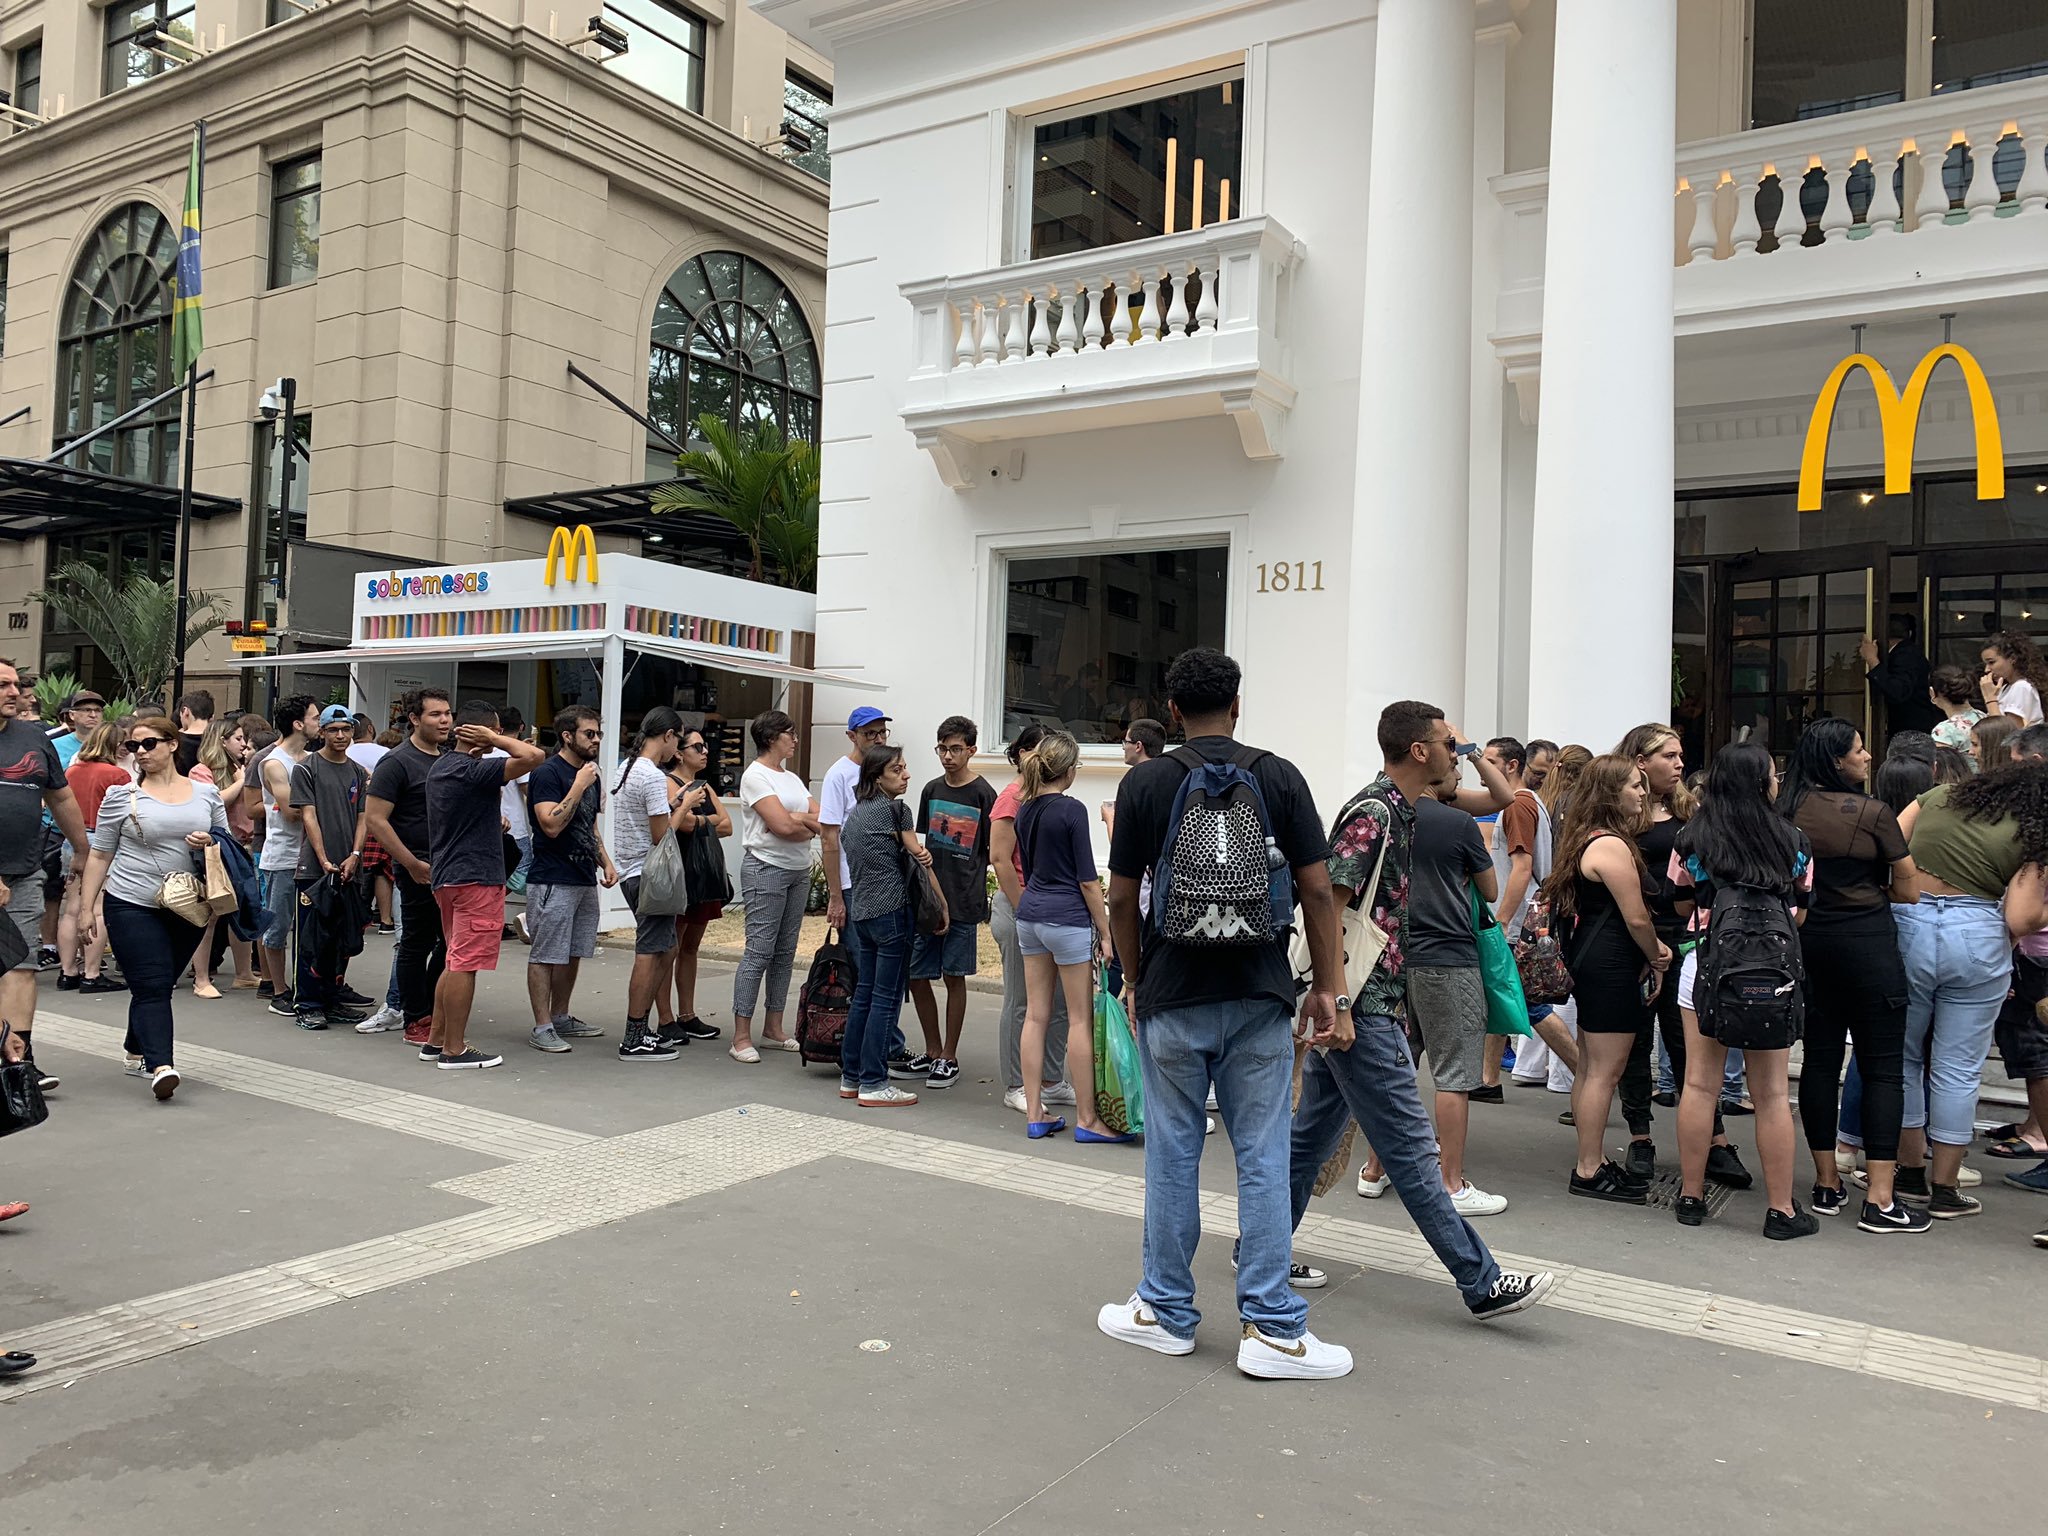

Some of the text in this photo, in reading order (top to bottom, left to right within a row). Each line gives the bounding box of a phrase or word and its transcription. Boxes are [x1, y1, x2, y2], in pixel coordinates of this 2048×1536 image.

[367, 570, 489, 599] sobremesas
[1256, 560, 1325, 593] 1811
[1216, 814, 1229, 864] Kappa
